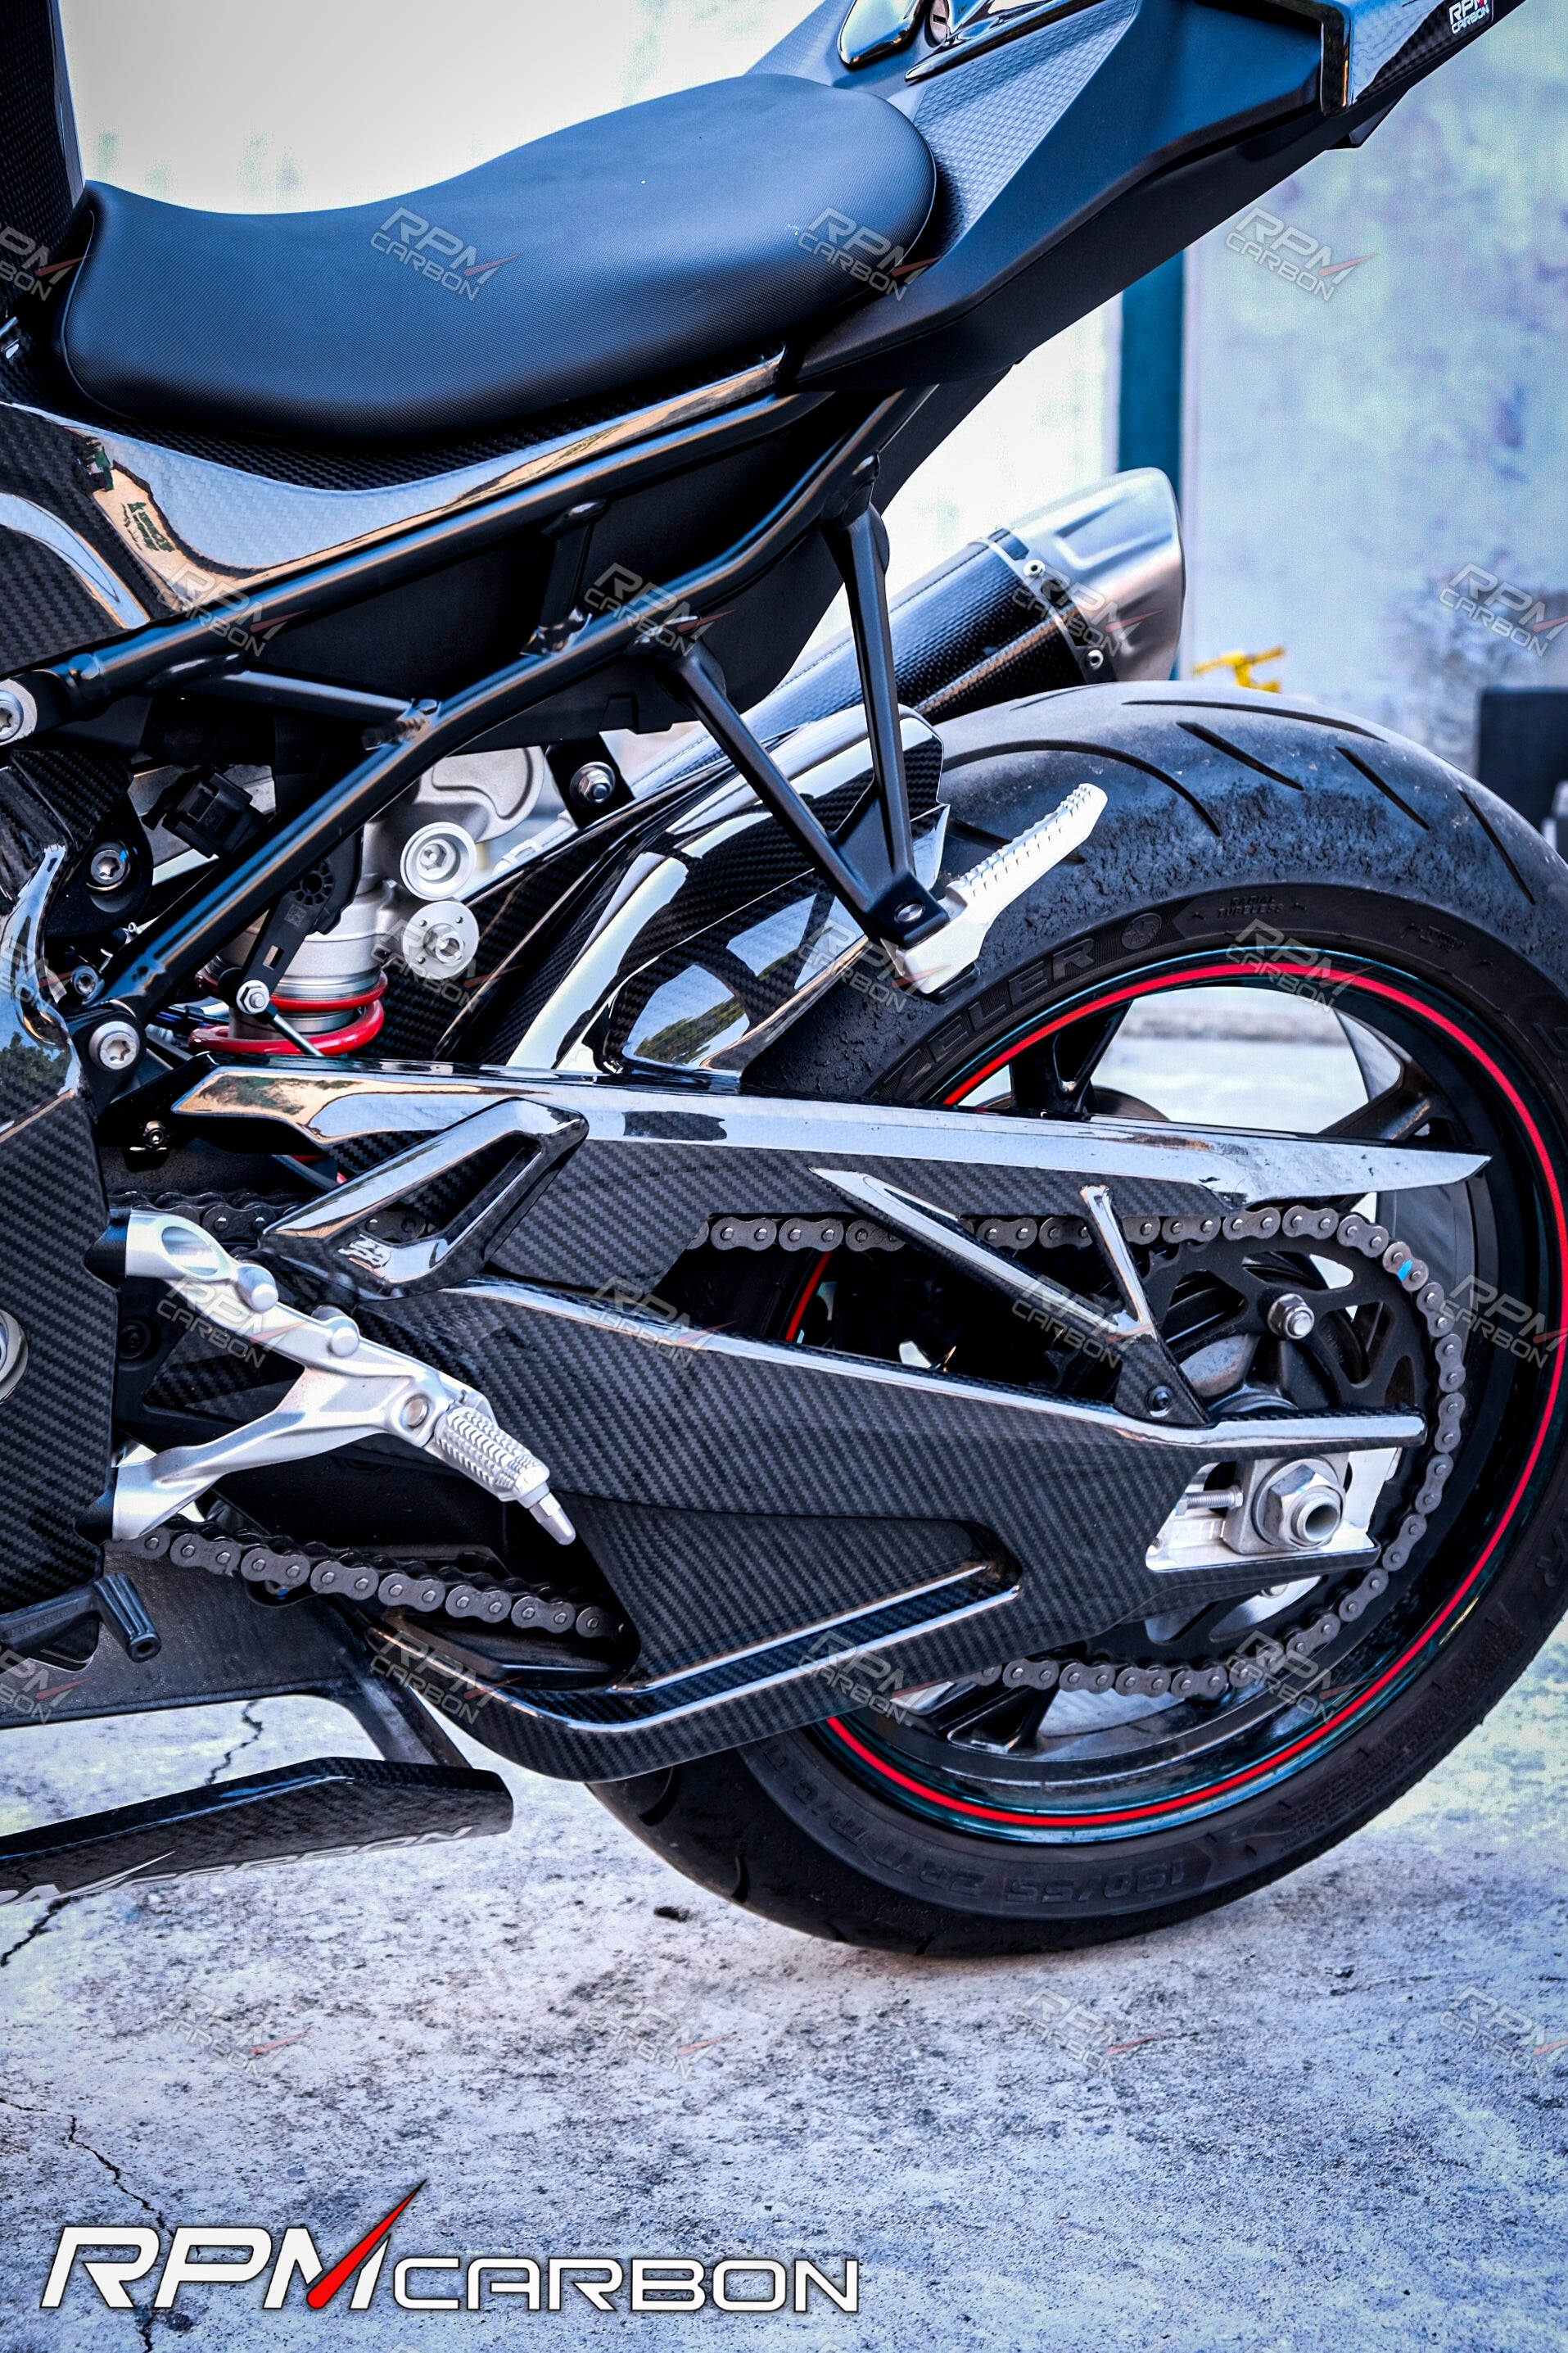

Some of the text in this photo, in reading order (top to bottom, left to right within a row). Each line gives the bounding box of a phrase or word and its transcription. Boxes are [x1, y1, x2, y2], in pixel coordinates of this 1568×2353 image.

[1451, 5, 1490, 34] CARBON
[1217, 903, 1285, 918] TUBELESS
[1229, 894, 1277, 907] RADIAL
[872, 938, 1096, 1100] ZELER
[1009, 1858, 1186, 1904] 190/55
